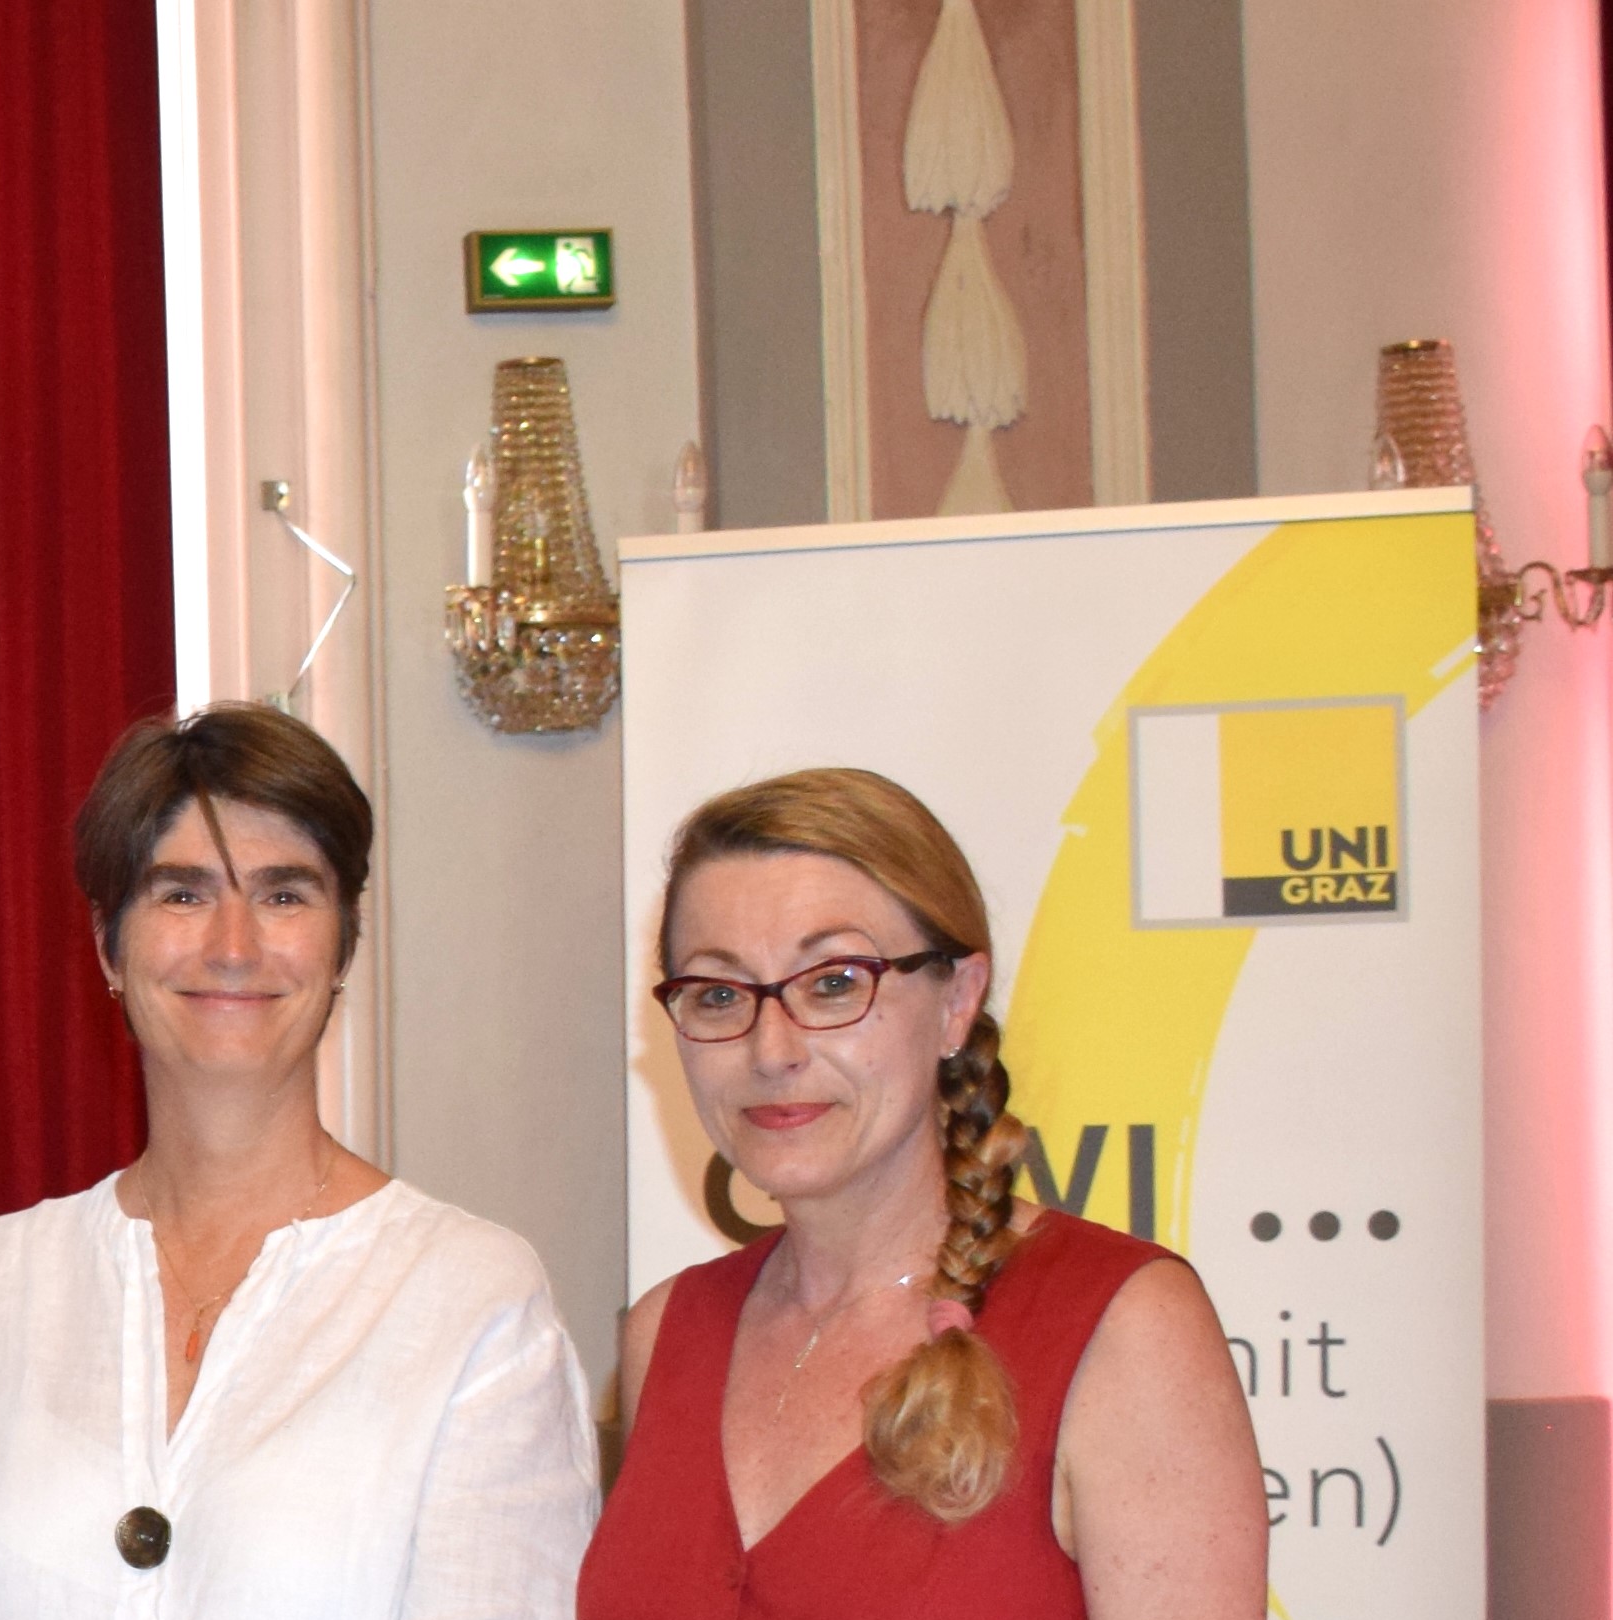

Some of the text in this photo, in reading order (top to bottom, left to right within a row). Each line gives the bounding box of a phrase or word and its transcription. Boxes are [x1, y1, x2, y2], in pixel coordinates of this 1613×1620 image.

[1280, 824, 1389, 872] UNI
[1280, 874, 1391, 905] GRAZ
[1261, 1435, 1402, 1547] en)
